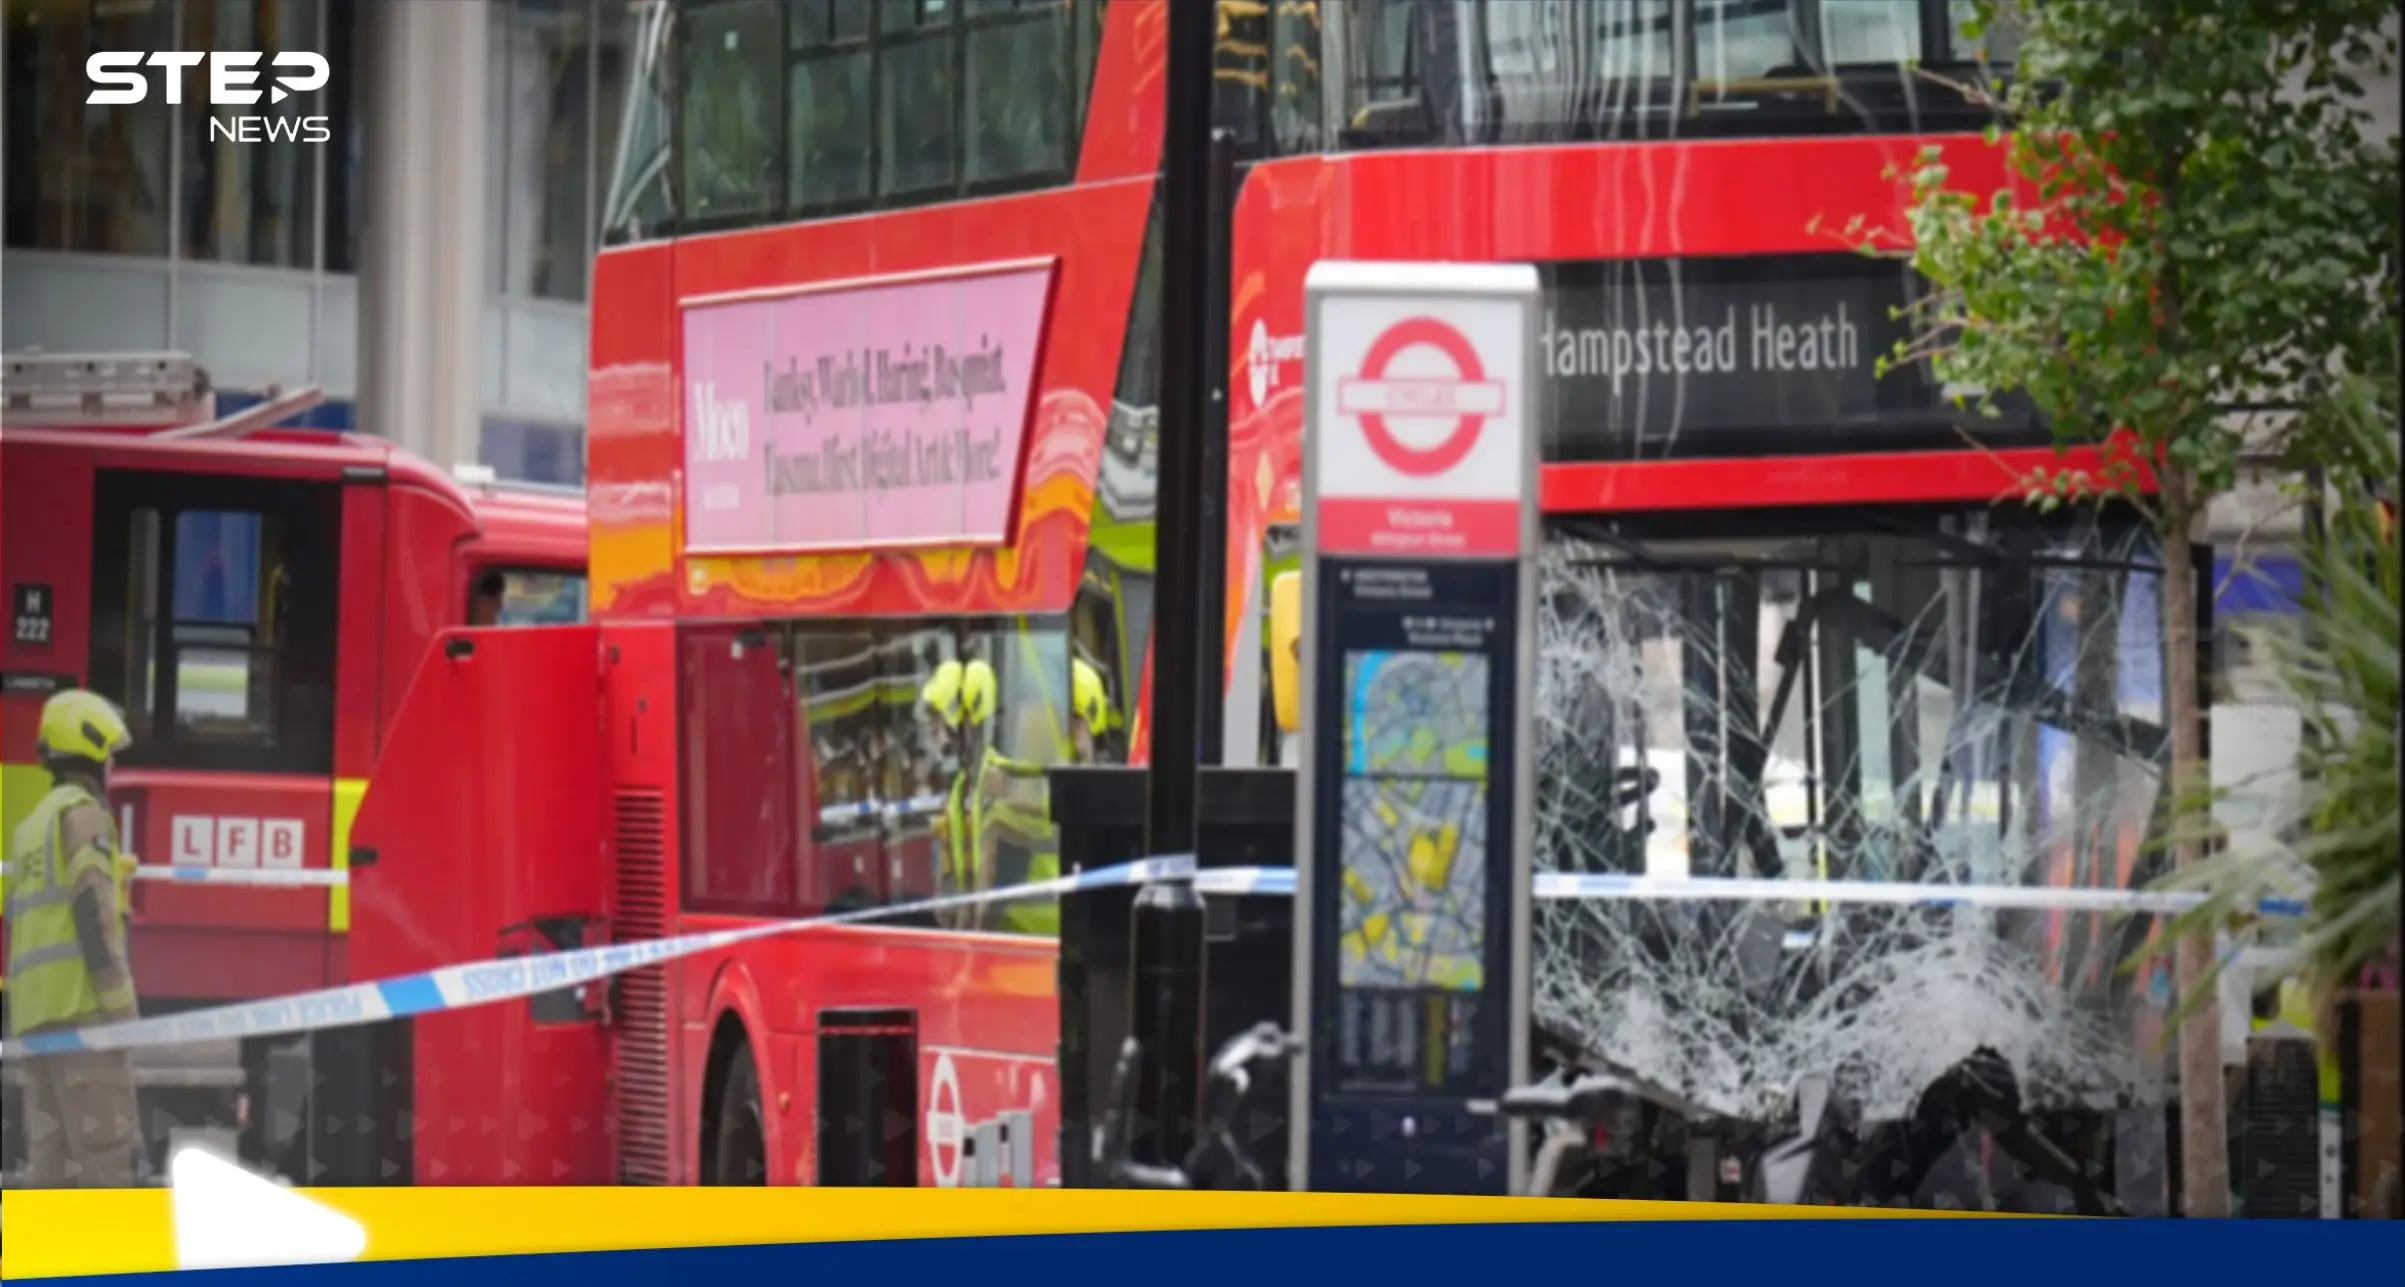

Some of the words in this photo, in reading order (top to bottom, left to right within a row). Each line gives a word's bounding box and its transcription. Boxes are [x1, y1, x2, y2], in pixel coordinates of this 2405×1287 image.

[1752, 301, 1857, 371] Heath
[26, 588, 41, 614] H
[16, 616, 50, 642] 222
